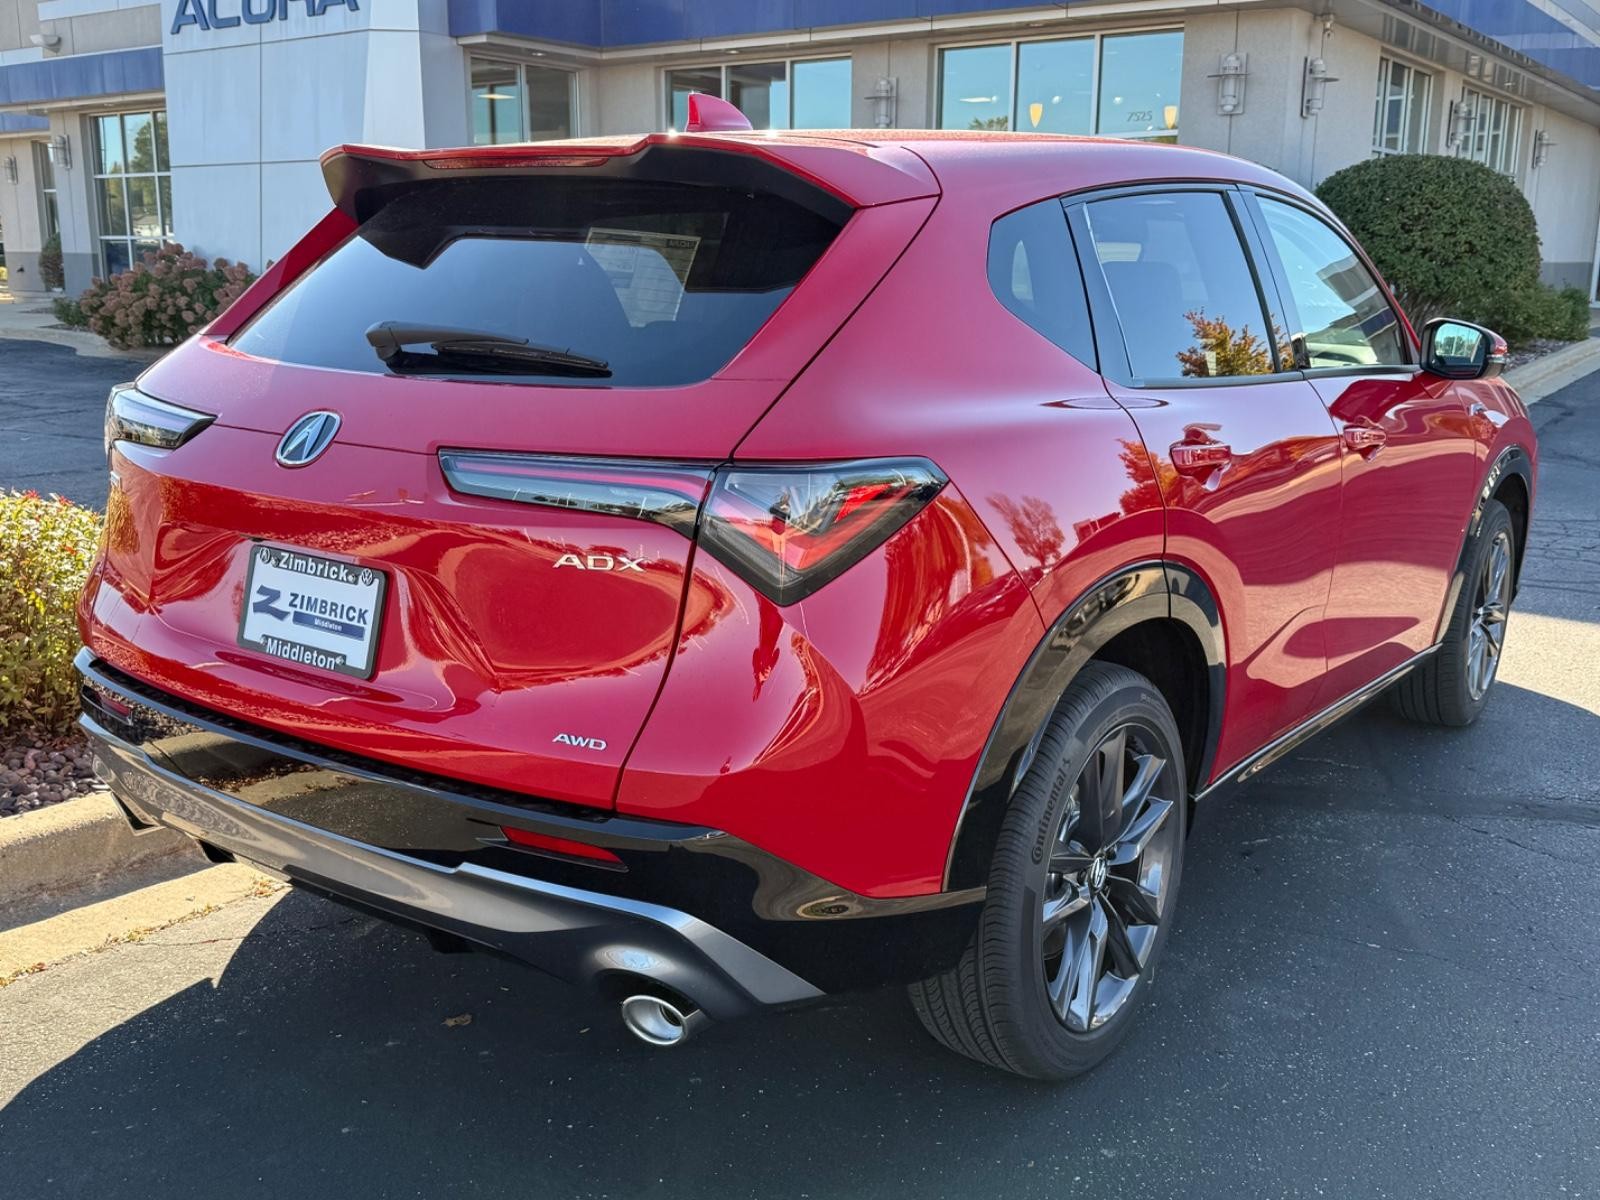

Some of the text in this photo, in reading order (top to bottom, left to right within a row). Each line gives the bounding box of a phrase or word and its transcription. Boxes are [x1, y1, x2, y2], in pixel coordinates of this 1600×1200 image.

[278, 552, 347, 580] Zimbrick
[552, 553, 645, 572] ADX
[288, 592, 369, 625] ZIMBRICK
[266, 638, 336, 670] Middleton
[552, 733, 607, 751] AWD
[1031, 769, 1067, 864] Continental
